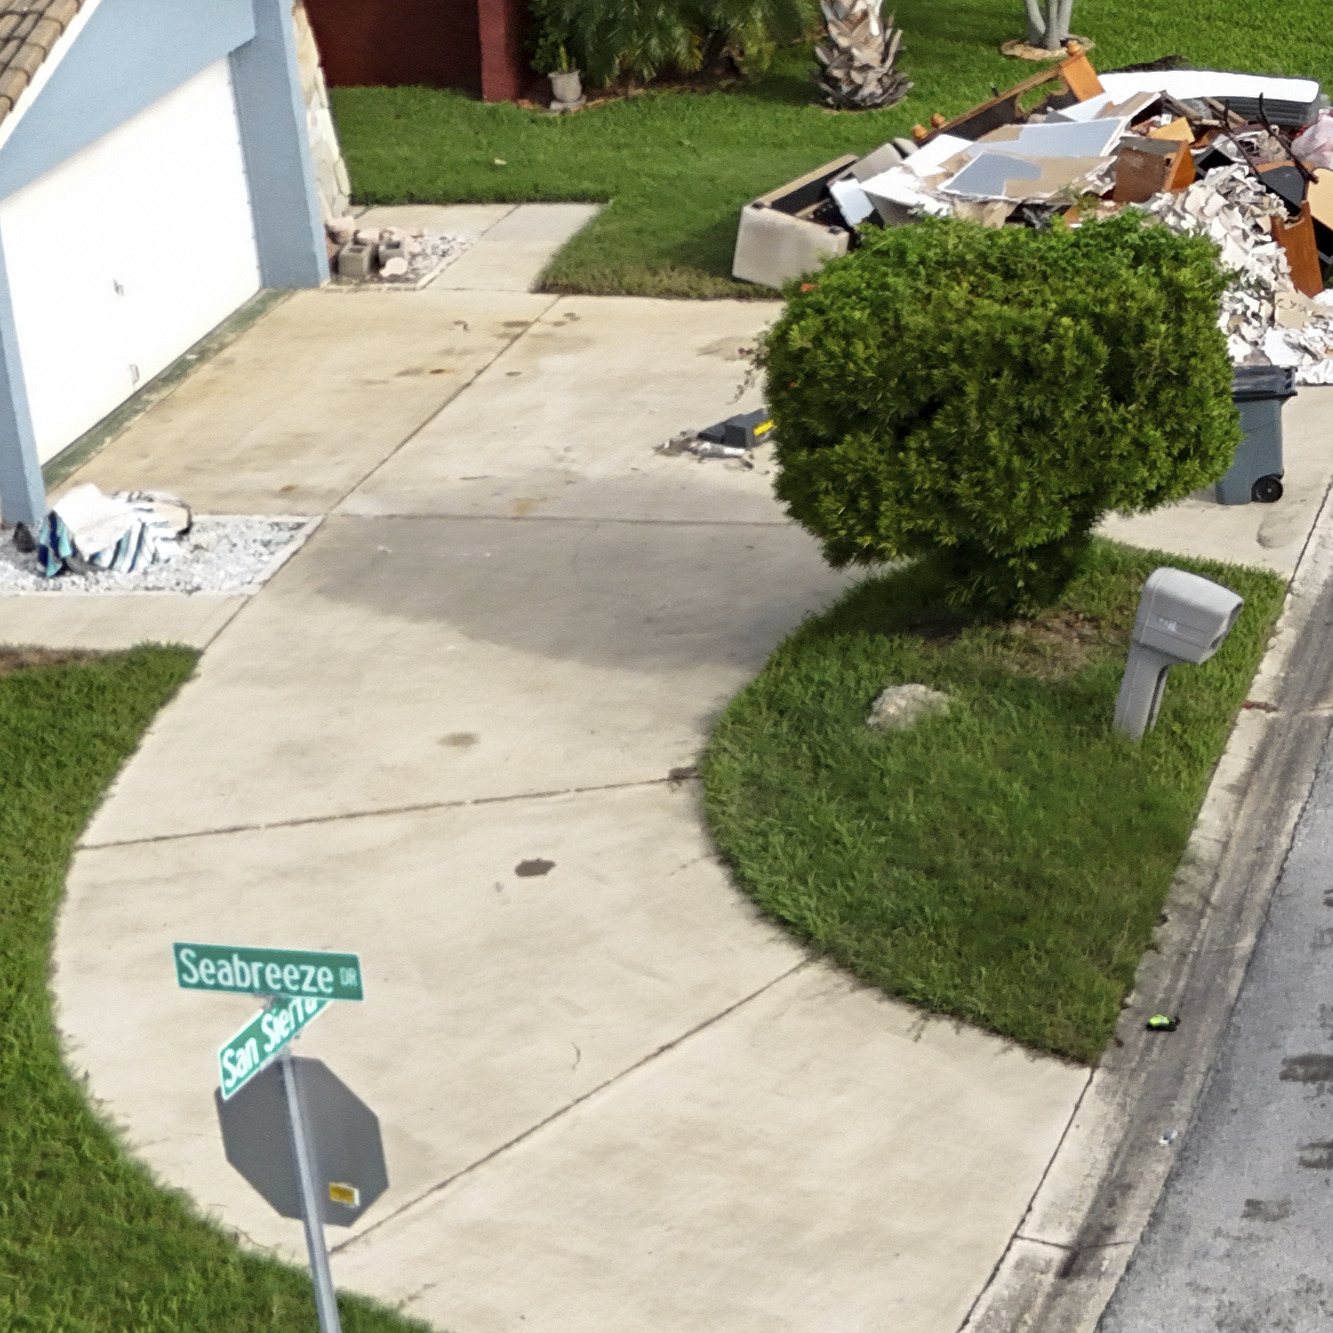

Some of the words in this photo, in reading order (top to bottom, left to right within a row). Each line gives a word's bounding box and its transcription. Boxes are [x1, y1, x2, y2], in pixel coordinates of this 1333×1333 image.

[179, 948, 334, 994] Seabreeze
[339, 967, 358, 987] DR
[222, 1037, 259, 1088] San
